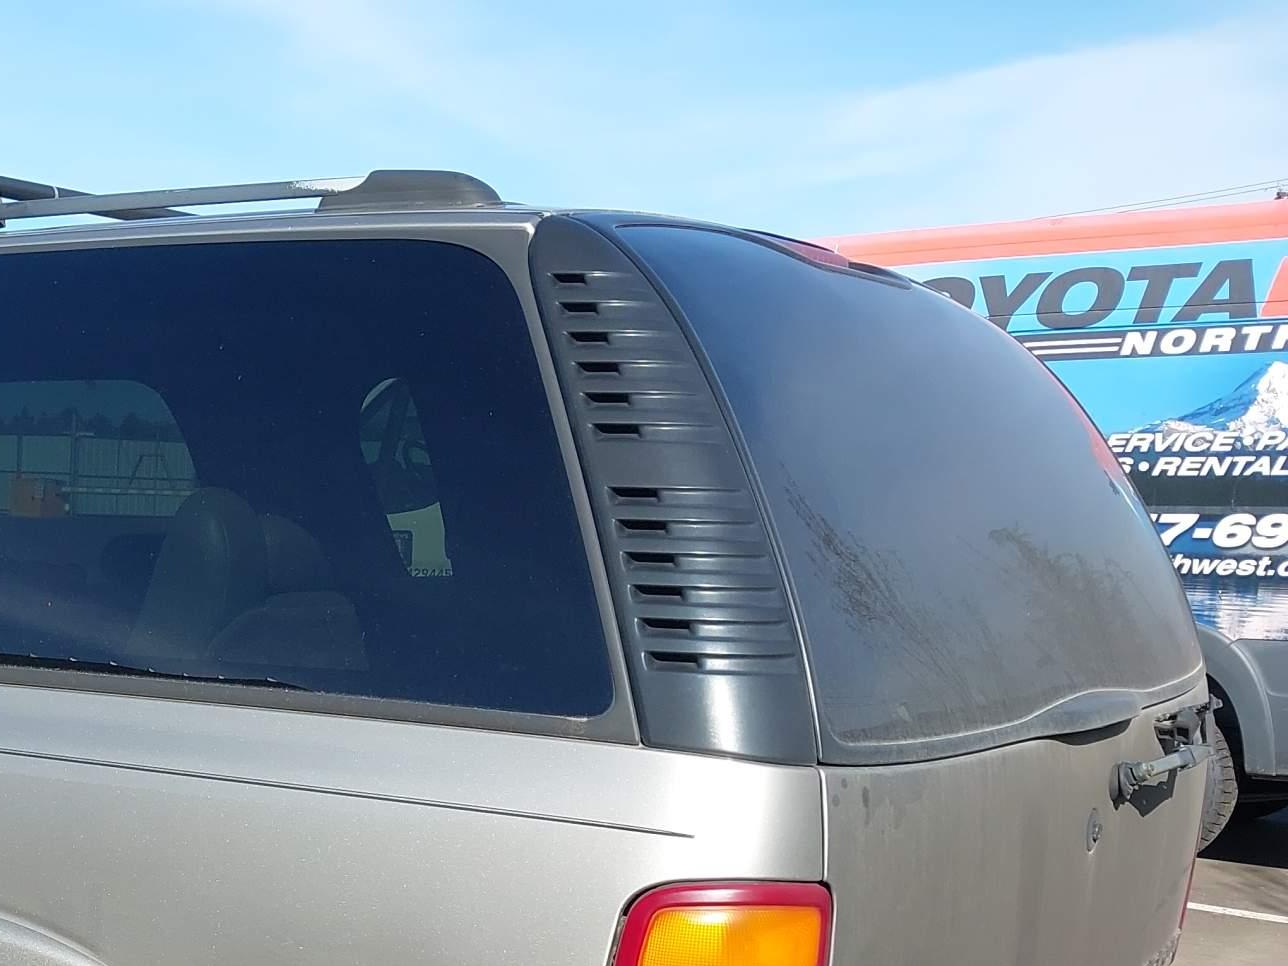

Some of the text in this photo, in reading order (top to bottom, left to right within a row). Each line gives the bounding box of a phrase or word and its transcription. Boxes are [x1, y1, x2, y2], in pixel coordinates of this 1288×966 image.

[1106, 430, 1288, 453] ERVICE P
[1152, 455, 1288, 476] RENTAL
[1150, 512, 1288, 549] 7-69
[1170, 553, 1288, 577] hwest.c
